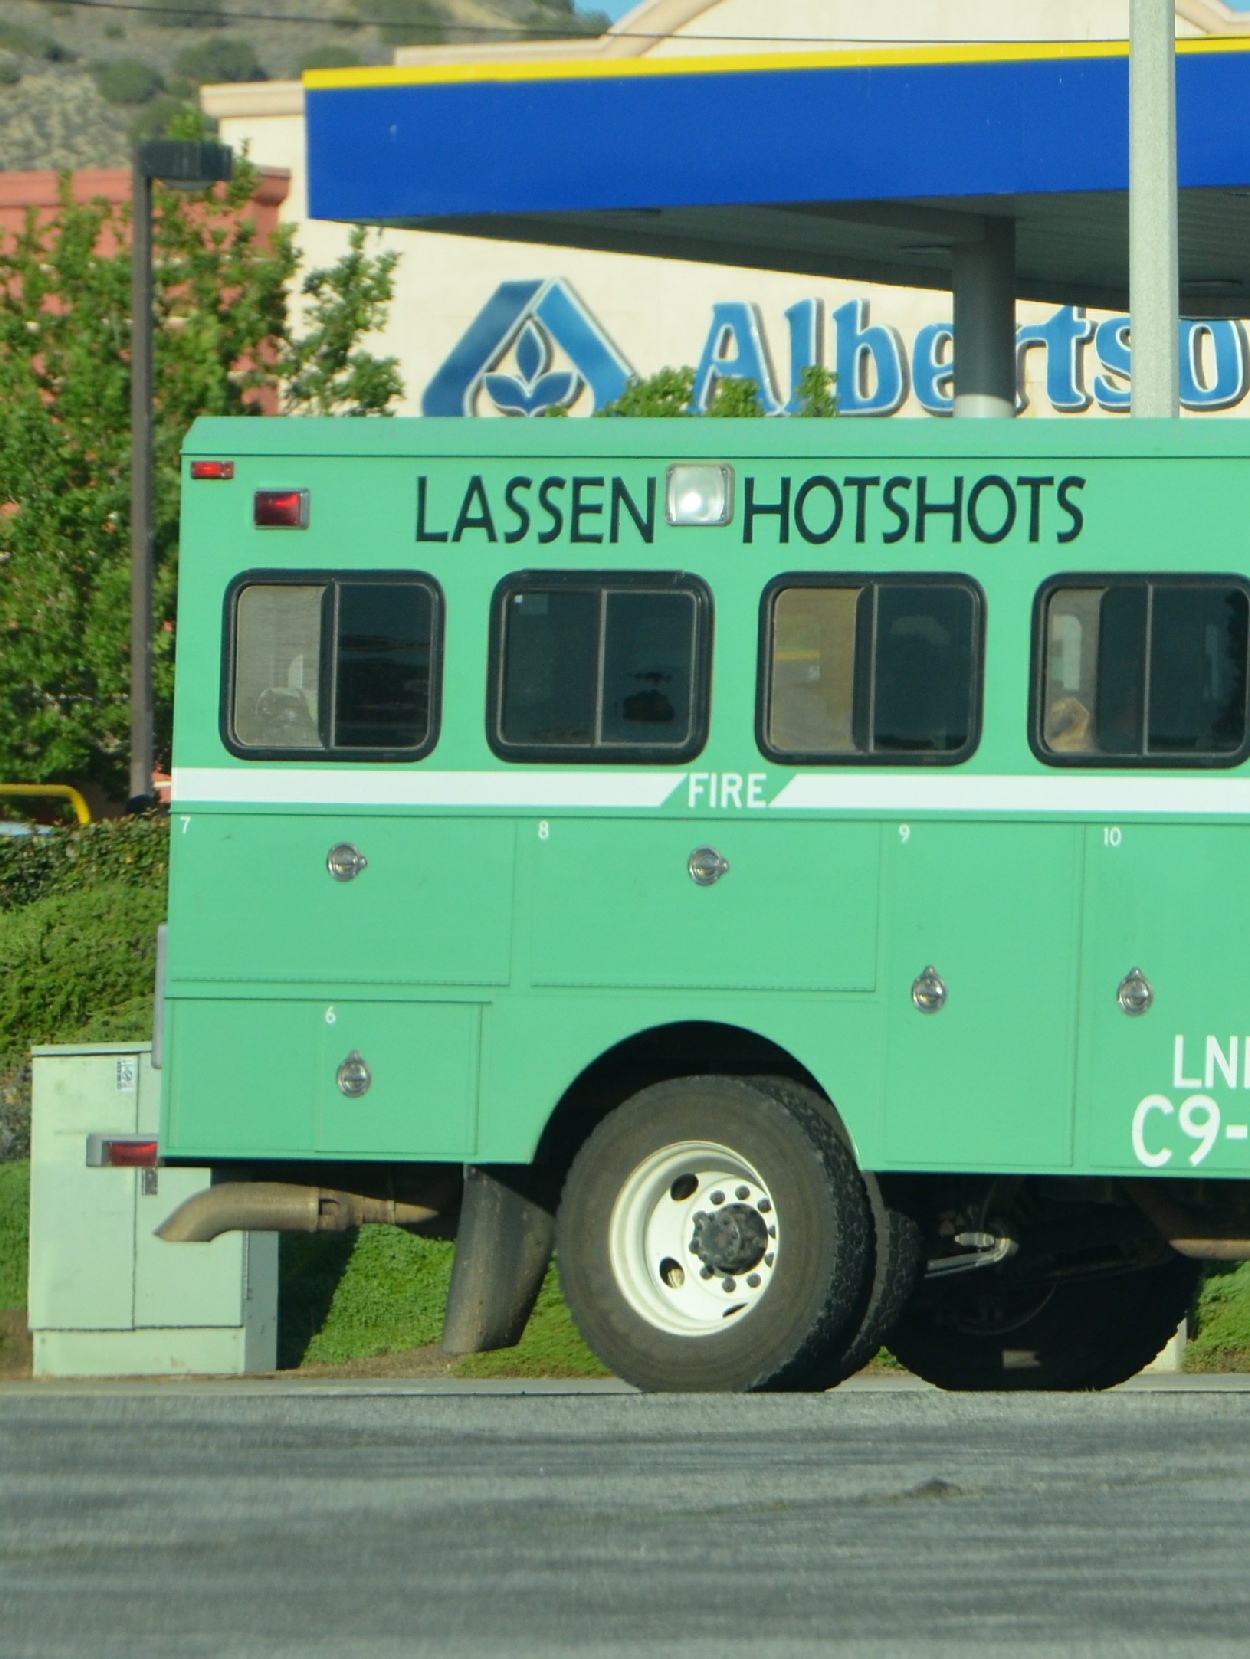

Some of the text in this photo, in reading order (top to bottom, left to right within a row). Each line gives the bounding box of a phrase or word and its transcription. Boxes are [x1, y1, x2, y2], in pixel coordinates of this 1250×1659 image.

[416, 475, 1086, 545] LASSEN HOTSHOTS
[688, 772, 767, 808] FIRE
[180, 815, 192, 834] 7
[537, 820, 550, 840] 8
[898, 823, 911, 844] 9
[1103, 826, 1122, 847] 10
[324, 1005, 337, 1024] 6
